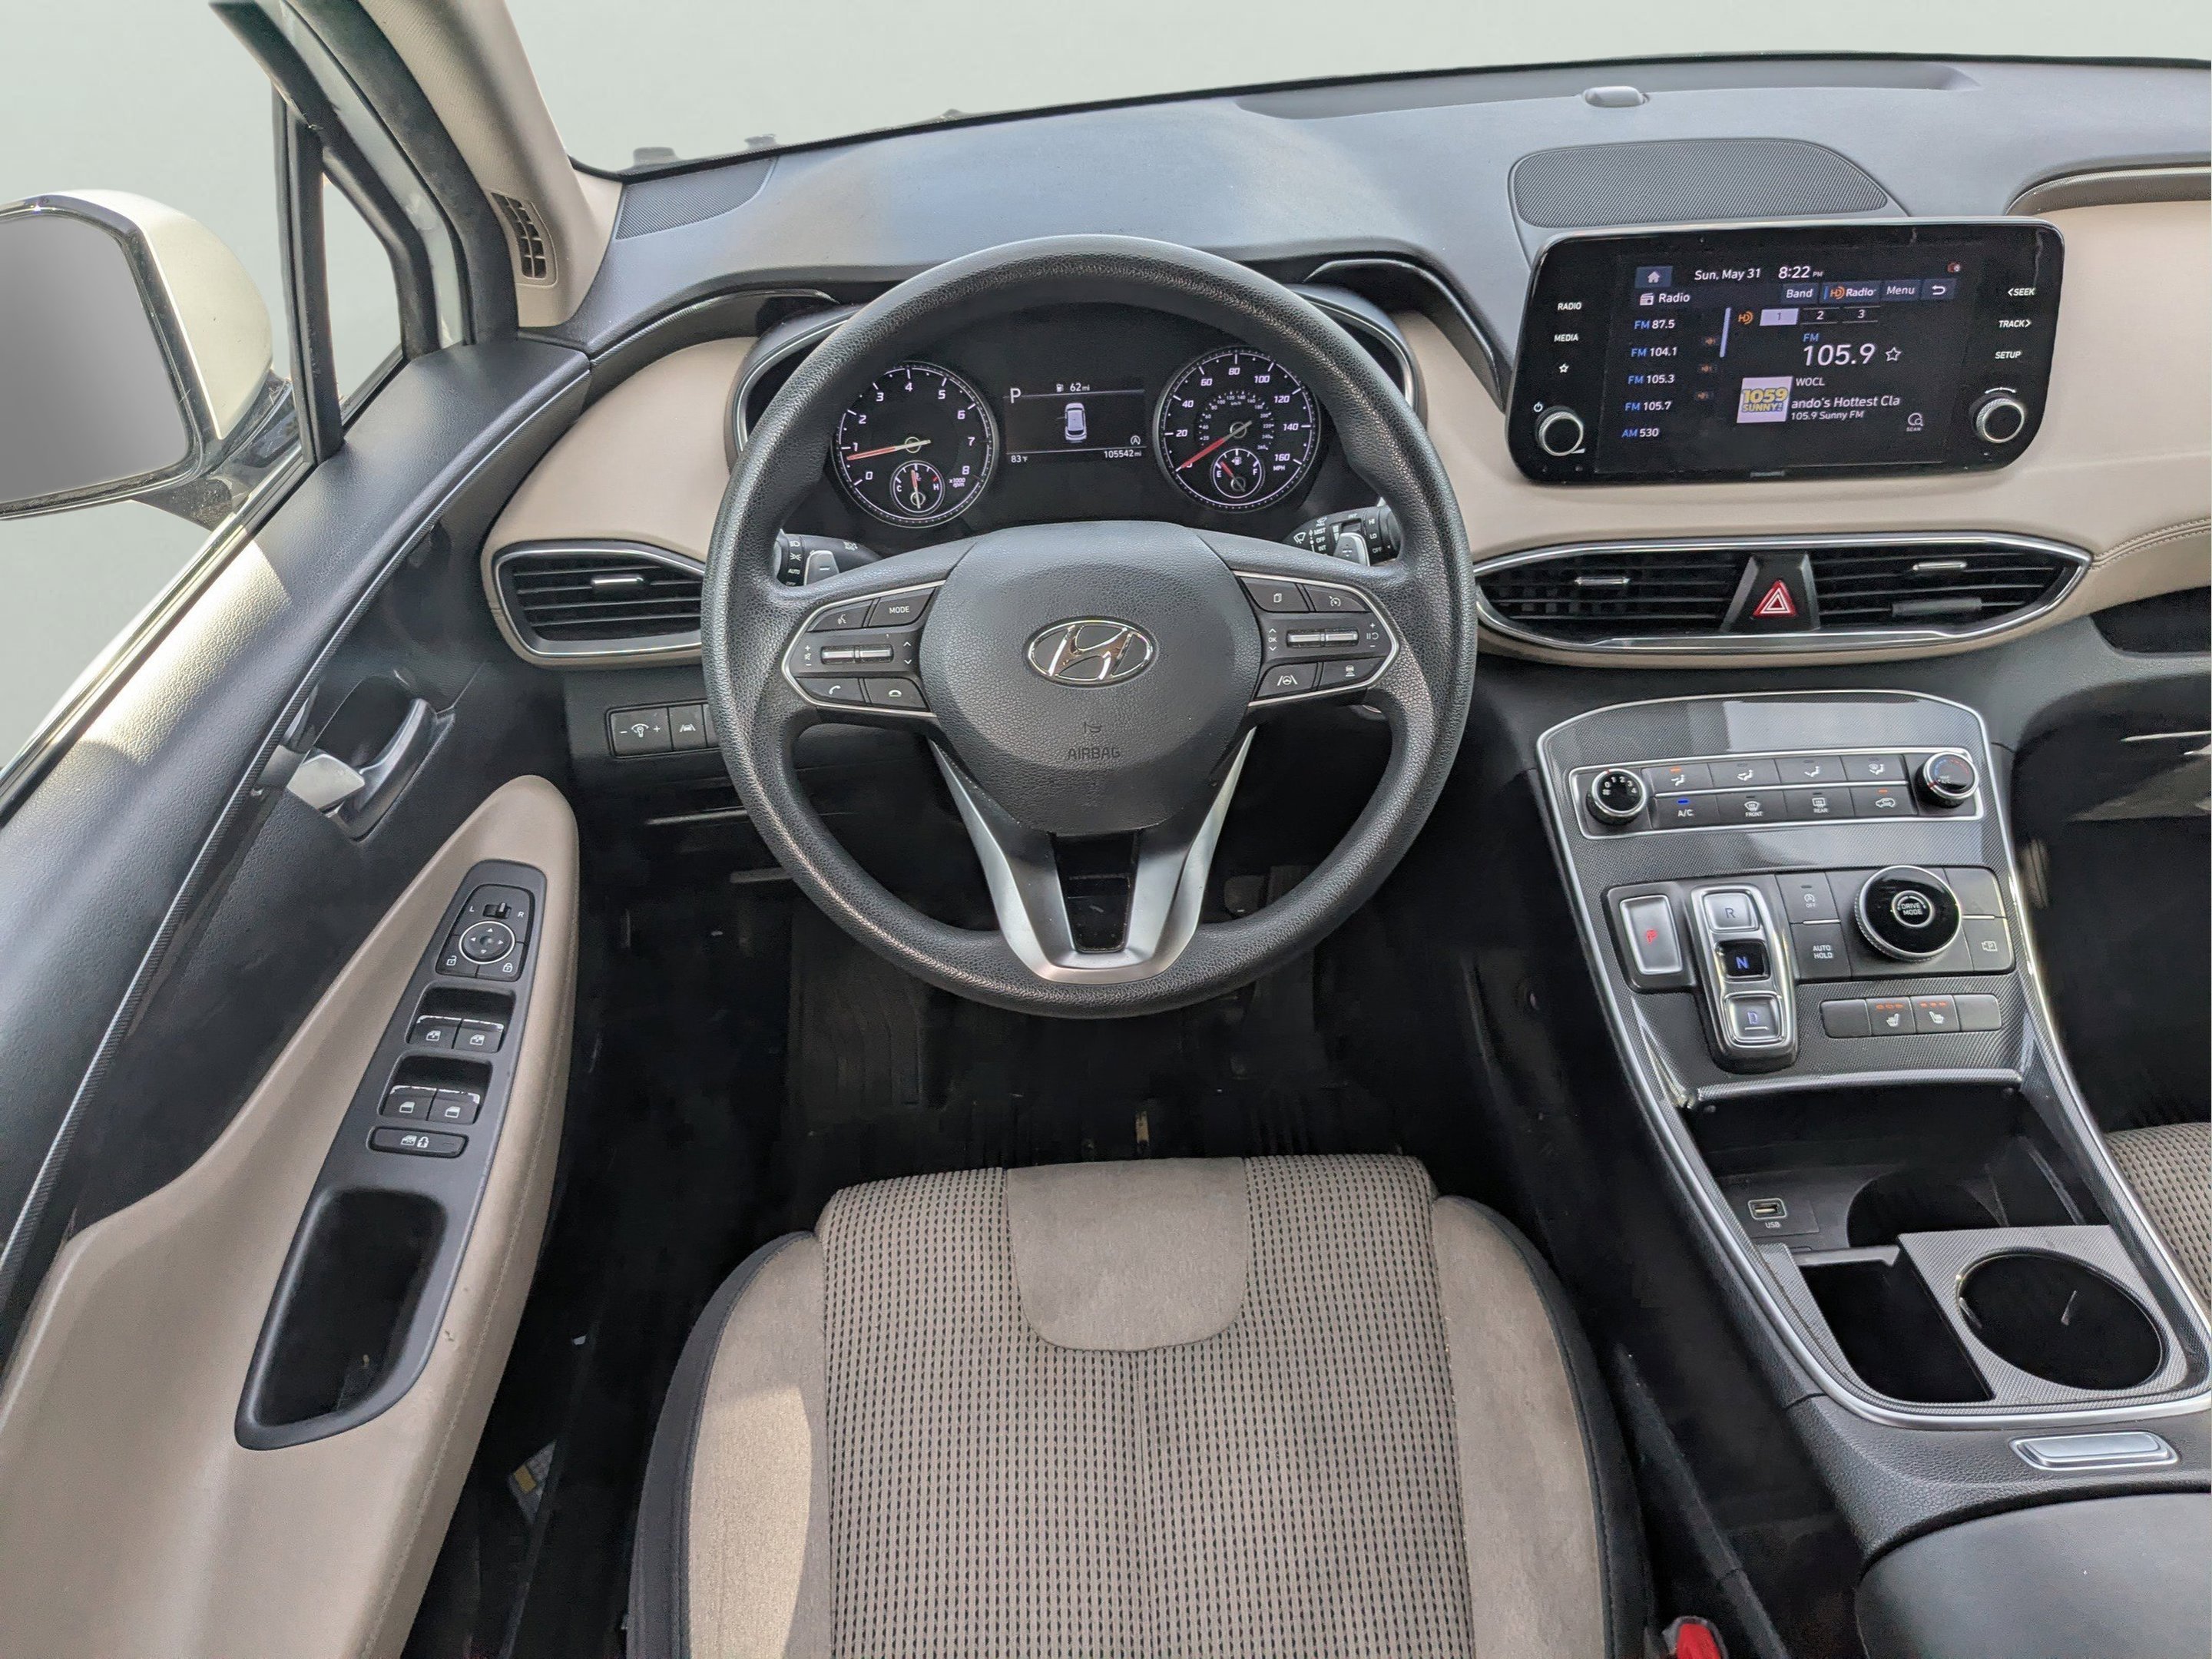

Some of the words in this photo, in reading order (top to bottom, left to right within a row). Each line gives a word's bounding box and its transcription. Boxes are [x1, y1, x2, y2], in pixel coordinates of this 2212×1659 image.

[1694, 270, 1719, 281] Sun,
[1722, 270, 1744, 281] May
[1747, 269, 1760, 278] 31
[1778, 266, 1810, 279] 8:22
[1786, 289, 1813, 299] Band
[1886, 286, 1915, 295] Menu
[1658, 293, 1690, 303] Radio
[1816, 310, 1824, 320] 2
[1857, 310, 1866, 319] 3
[1634, 320, 1650, 329] FM
[1652, 320, 1675, 329] 87.5
[1803, 333, 1819, 342] FM
[1650, 347, 1677, 356] 104.1
[1803, 343, 1876, 366] 105.9
[1628, 376, 1643, 384] FM
[1647, 375, 1674, 383] 105.3
[1796, 378, 1825, 386] WOCL
[906, 382, 912, 391] 4
[876, 392, 884, 402] 3
[938, 390, 945, 399] 5
[1010, 388, 1022, 403] P
[1742, 387, 1788, 402] 1059
[1625, 402, 1641, 411] FM
[1644, 402, 1671, 410] 105.7
[1743, 403, 1777, 412] SUNNY
[1791, 398, 1830, 409] ando's
[1834, 397, 1877, 408] Hottest
[1881, 396, 1900, 406] Cla
[958, 410, 965, 419] 6
[1820, 412, 1847, 420] Sunny
[859, 416, 866, 424] 2
[1640, 429, 1659, 437] 530
[968, 437, 975, 446] 7
[853, 442, 858, 452] 1
[962, 465, 969, 475] 8
[1068, 747, 1121, 760] AIRBAG
[1724, 908, 1736, 919] R
[1646, 929, 1658, 944] P
[1736, 956, 1749, 969] N
[1747, 1011, 1759, 1025] D
